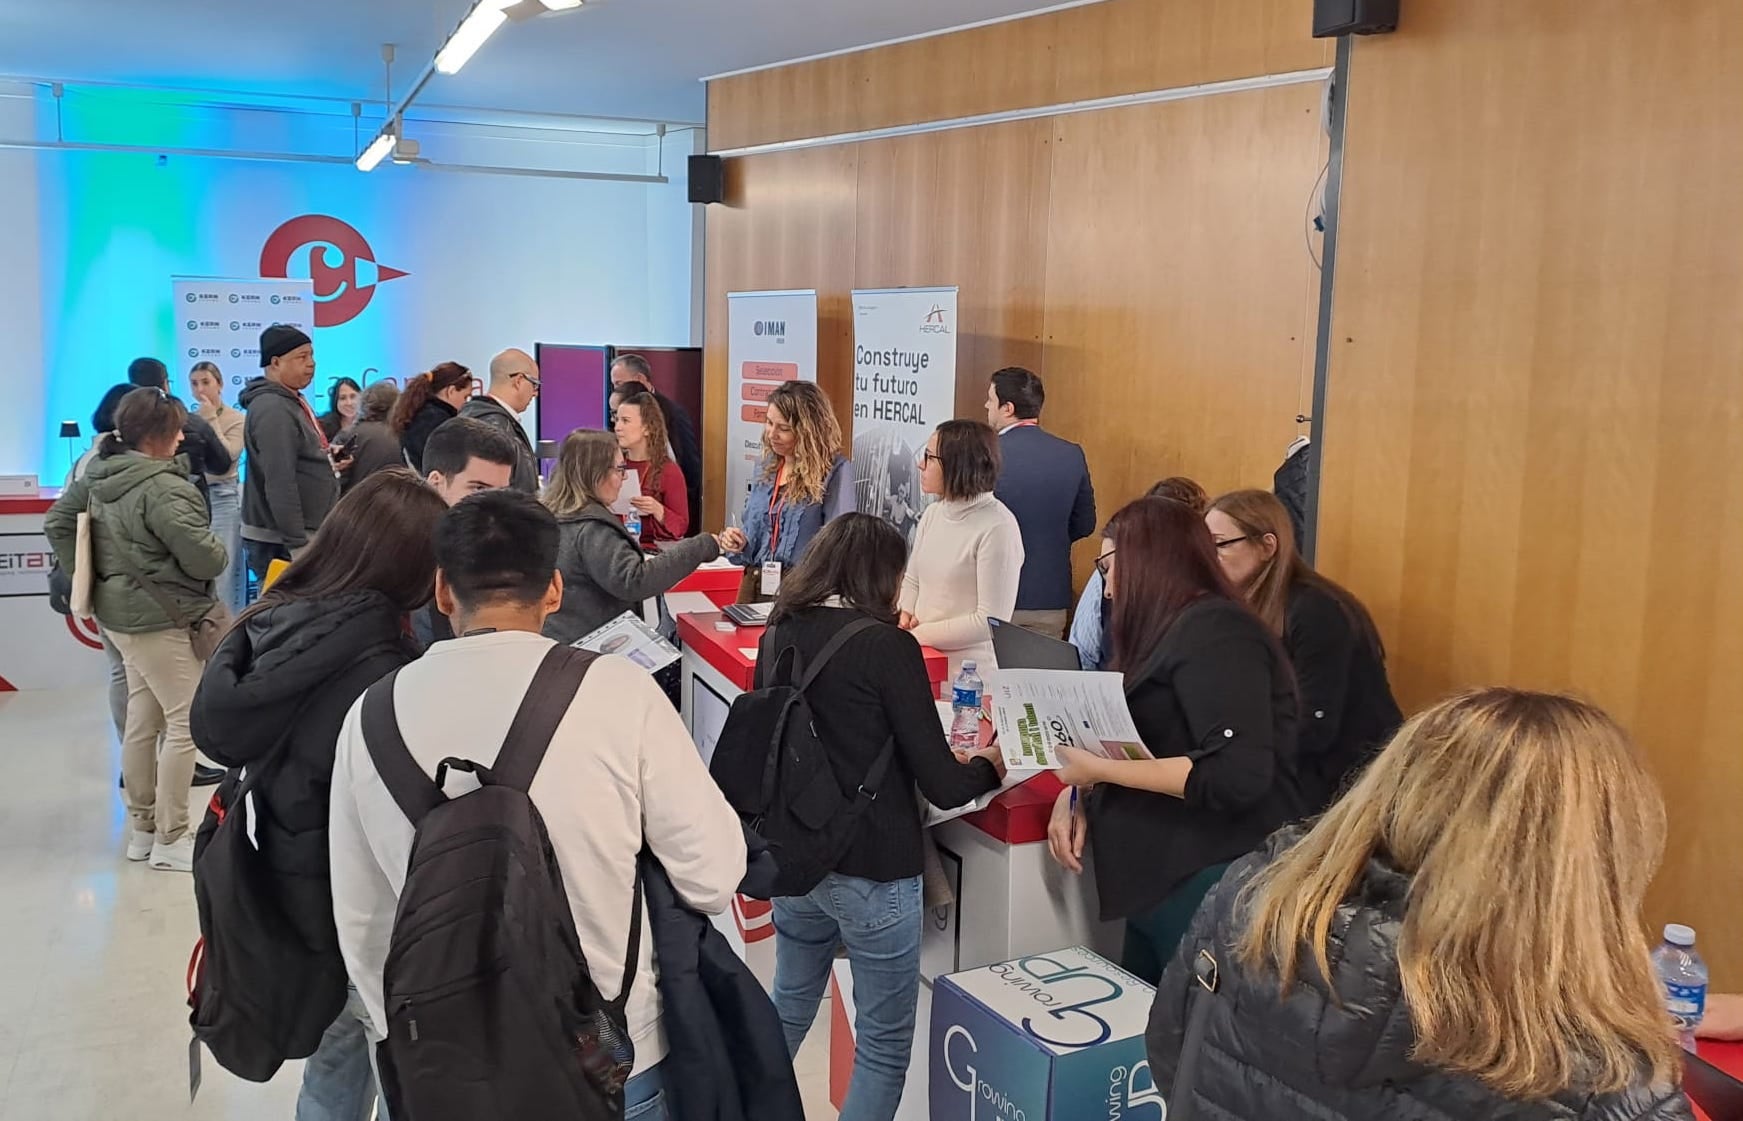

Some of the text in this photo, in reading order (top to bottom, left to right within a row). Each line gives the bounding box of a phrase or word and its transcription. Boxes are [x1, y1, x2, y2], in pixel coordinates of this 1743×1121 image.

[919, 325, 951, 334] HERCAL
[856, 345, 929, 373] Construye
[856, 373, 918, 396] tu futuro
[854, 400, 926, 426] en HERCAL
